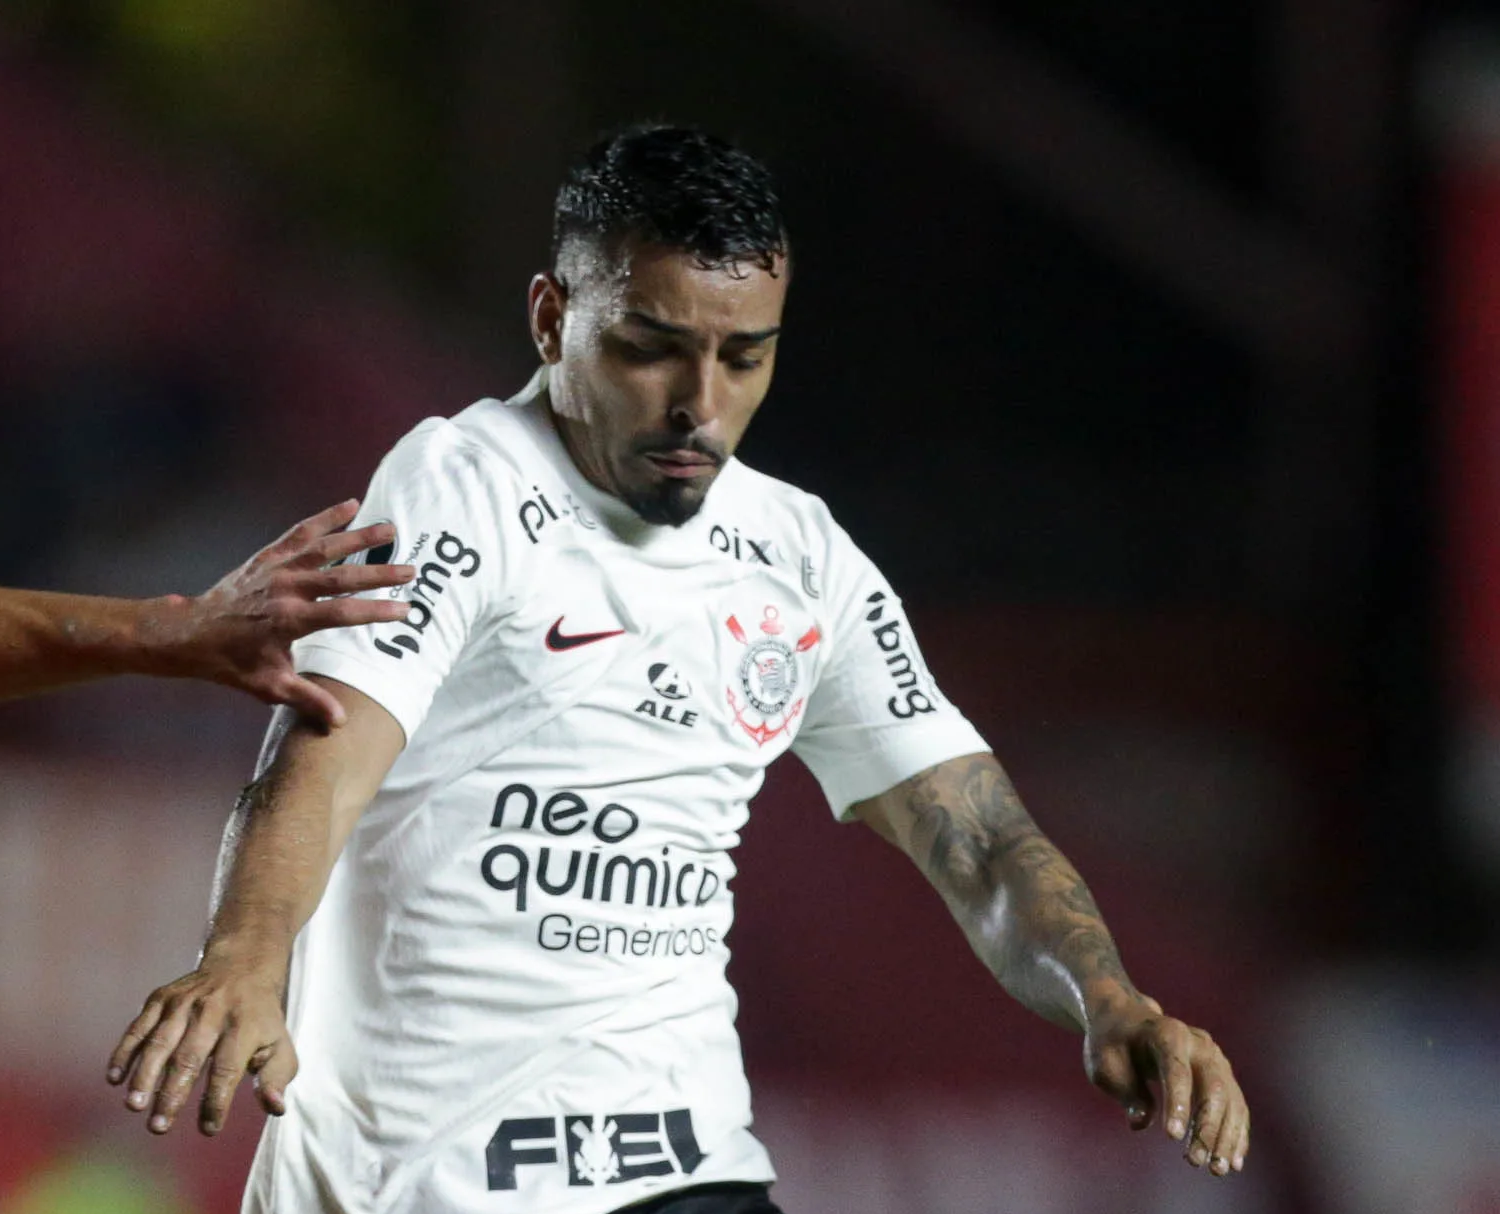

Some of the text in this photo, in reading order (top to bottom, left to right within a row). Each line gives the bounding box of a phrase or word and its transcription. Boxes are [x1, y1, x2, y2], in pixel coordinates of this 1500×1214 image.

[400, 530, 481, 635] bmg
[872, 619, 937, 719] bmg
[634, 699, 698, 727] ALE
[490, 783, 639, 844] neo
